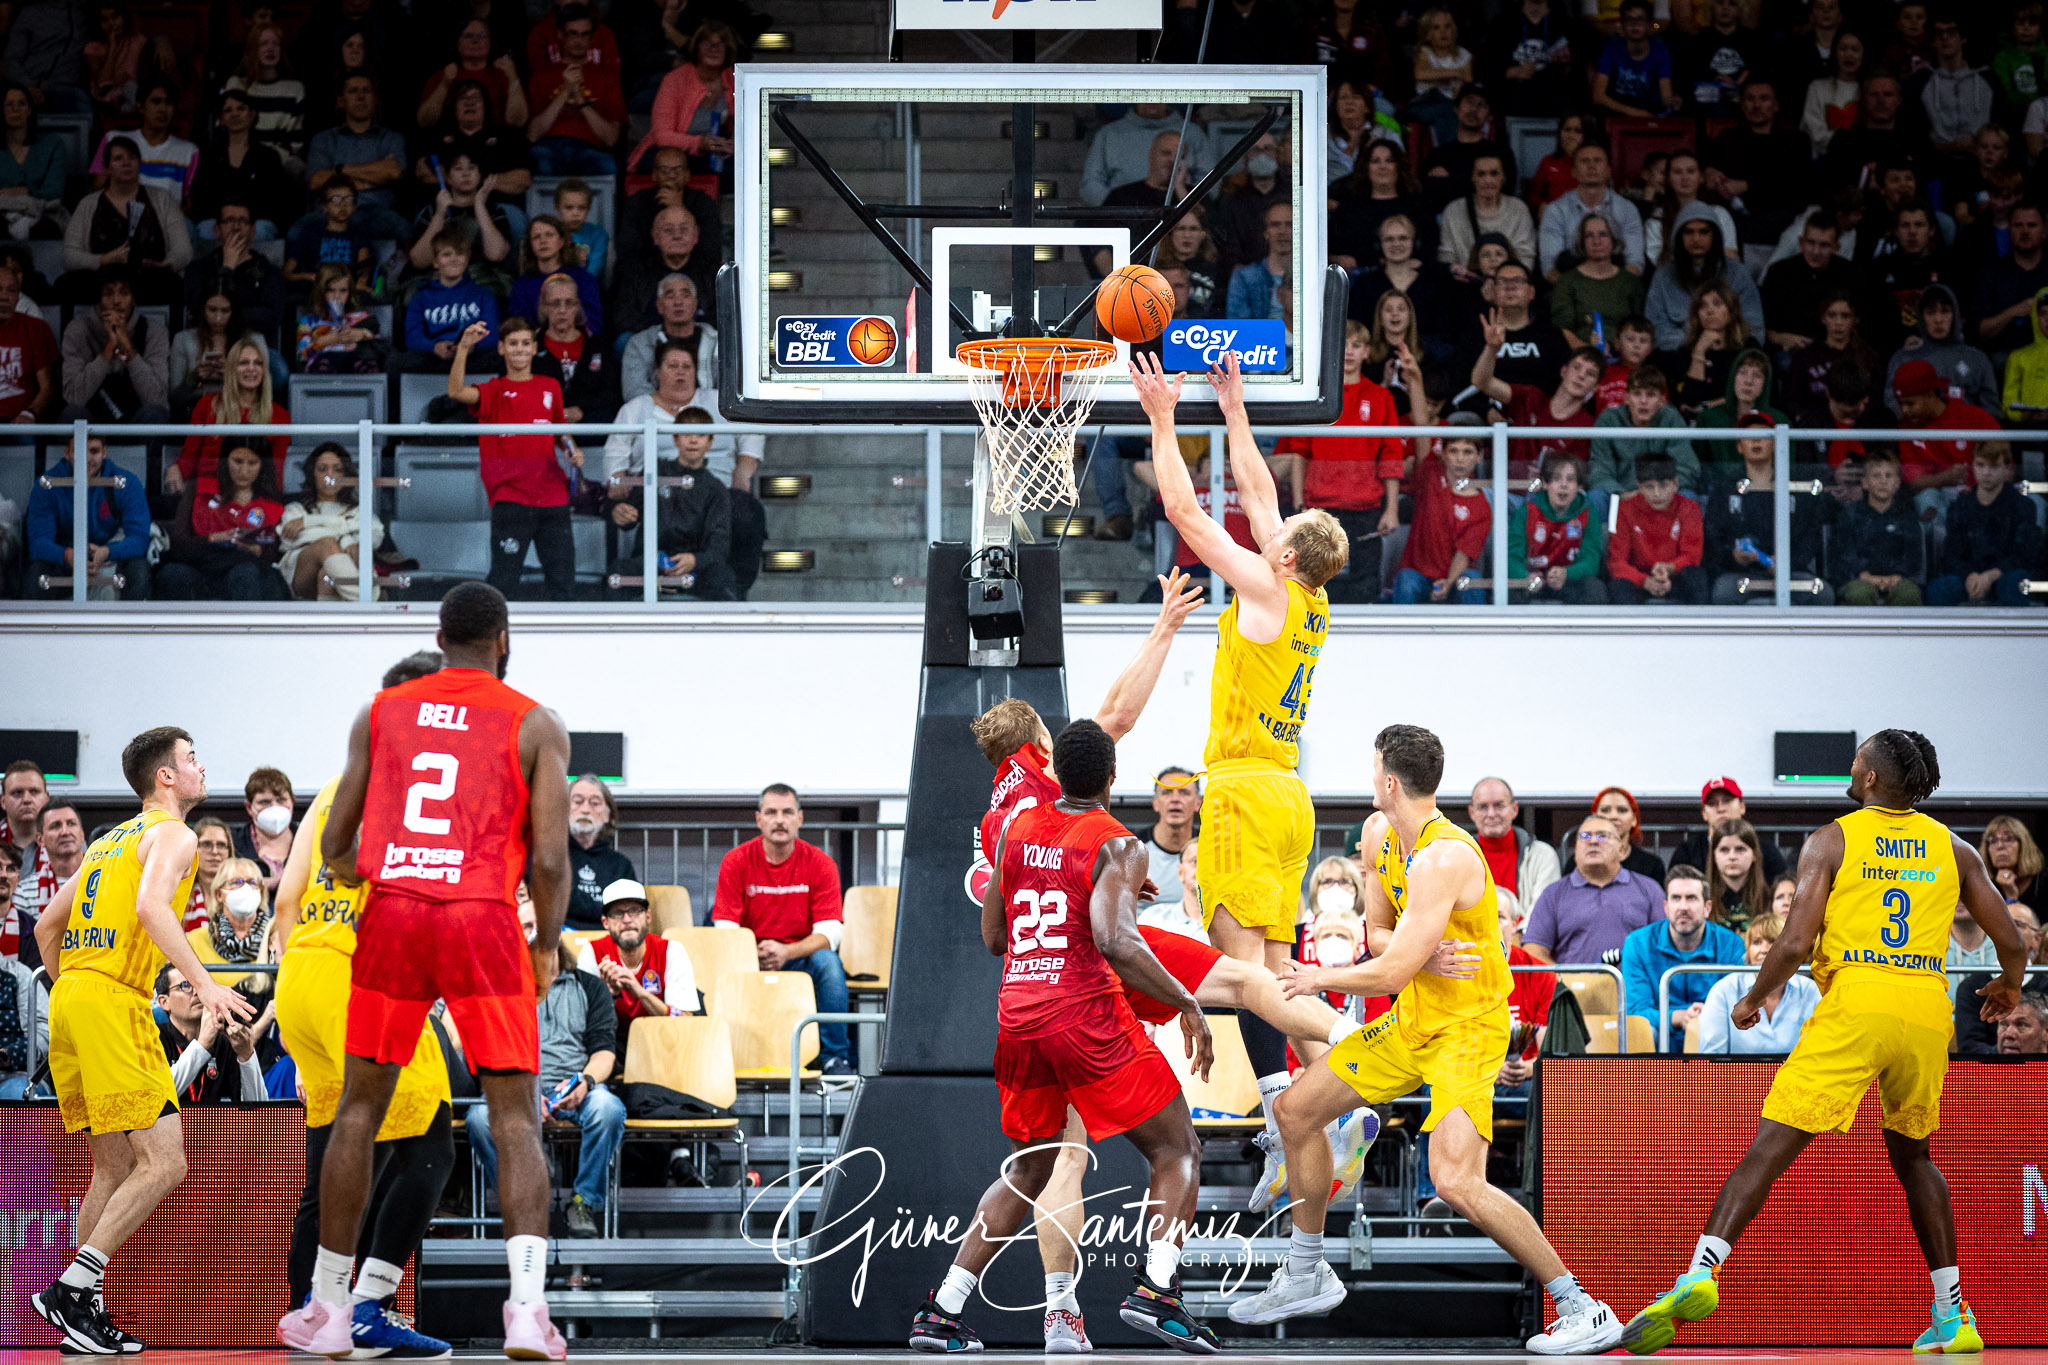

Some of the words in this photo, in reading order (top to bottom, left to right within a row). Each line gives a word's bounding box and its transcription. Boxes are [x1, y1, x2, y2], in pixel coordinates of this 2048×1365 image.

[1142, 298, 1163, 334] ALDING
[800, 330, 837, 341] Credit
[785, 341, 836, 362] BBL
[1202, 344, 1278, 366] Credit
[1496, 341, 1541, 358] ASA
[416, 702, 469, 731] BELL
[403, 751, 460, 835] 2
[385, 842, 465, 866] brose
[1023, 843, 1063, 870] YOUNG
[1875, 836, 1926, 859] SMITH
[1862, 861, 1938, 883] interzero
[81, 868, 102, 919] 9
[1011, 888, 1068, 955] 22
[1881, 888, 1911, 949] 3
[83, 926, 116, 949] ERLIN
[1010, 957, 1065, 974] brose
[1005, 971, 1060, 984] bamberg
